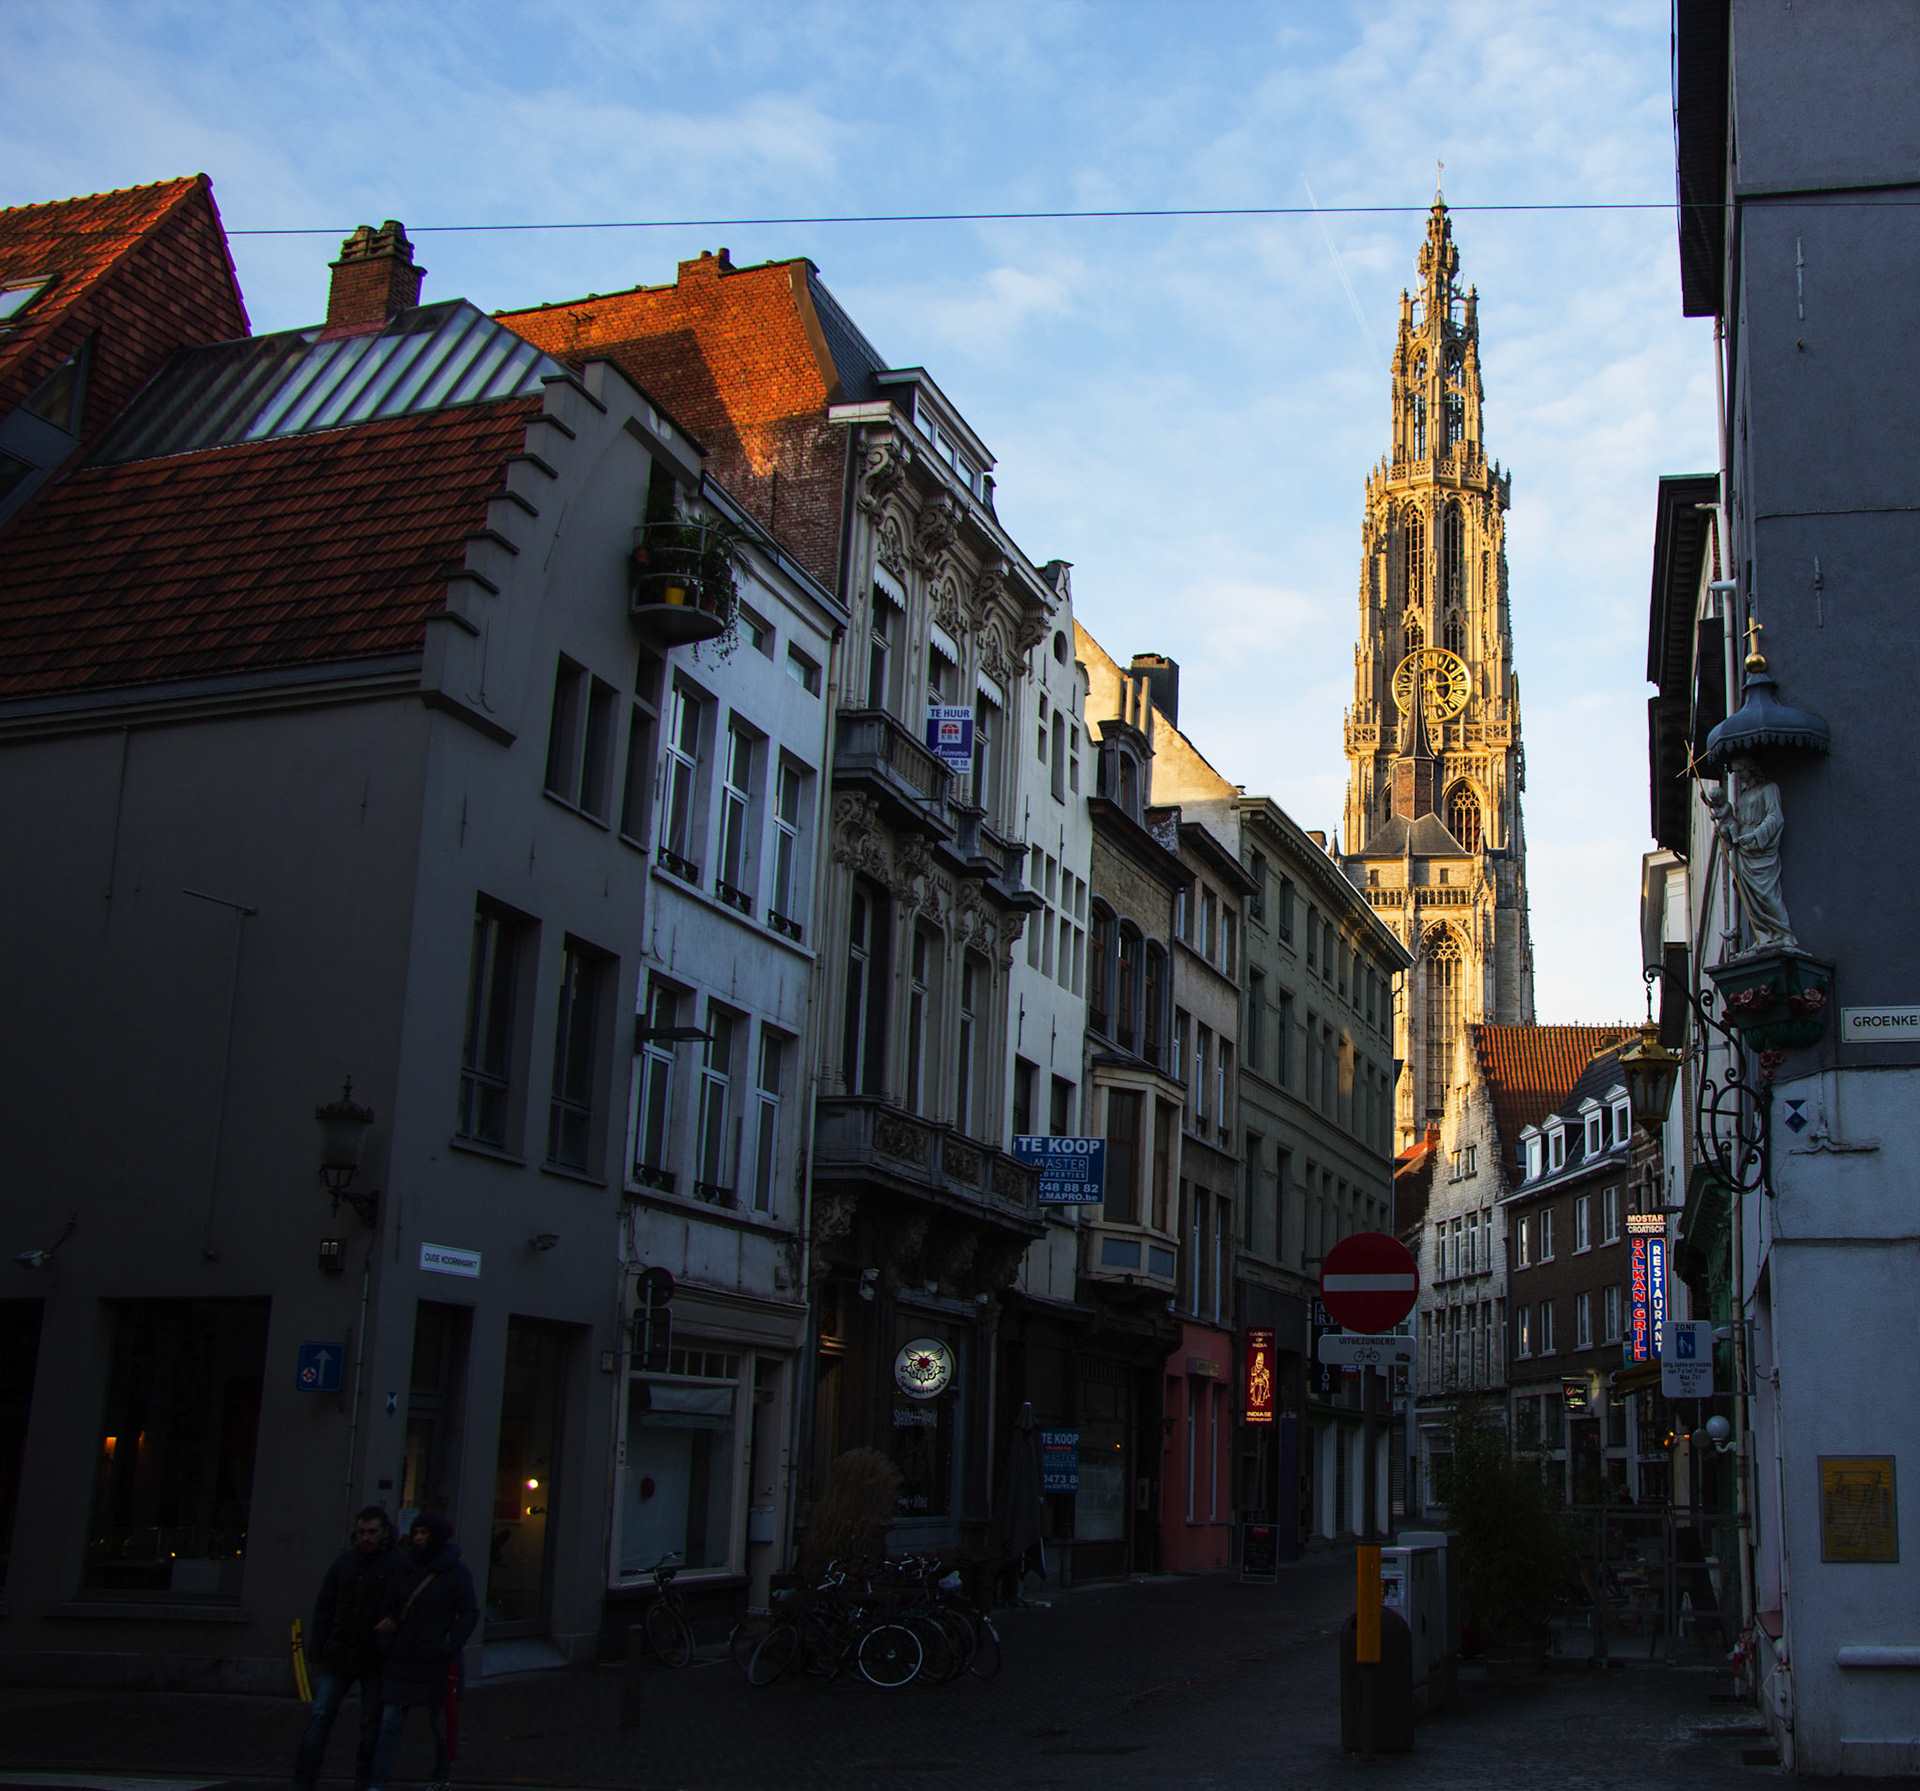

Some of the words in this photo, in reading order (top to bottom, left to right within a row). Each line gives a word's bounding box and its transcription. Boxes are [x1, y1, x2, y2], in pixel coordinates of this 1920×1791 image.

[930, 709, 941, 718] TE
[944, 709, 970, 718] HUUR
[1853, 1015, 1920, 1027] GROENKE
[1019, 1138, 1043, 1152] TE
[1048, 1138, 1100, 1154] KOOP
[1034, 1158, 1086, 1169] MASTER
[1063, 1183, 1079, 1192] 88
[1083, 1184, 1099, 1193] 82
[1627, 1214, 1664, 1223] MOSTAR
[1627, 1225, 1664, 1234] CROATISCH
[425, 1253, 440, 1262] OUDE
[441, 1256, 477, 1268] KOORNMARKT
[1652, 1245, 1663, 1352] RESTAURANT
[1674, 1323, 1696, 1331] ZONE
[1041, 1433, 1053, 1444] TE
[1054, 1433, 1079, 1445] KOOP
